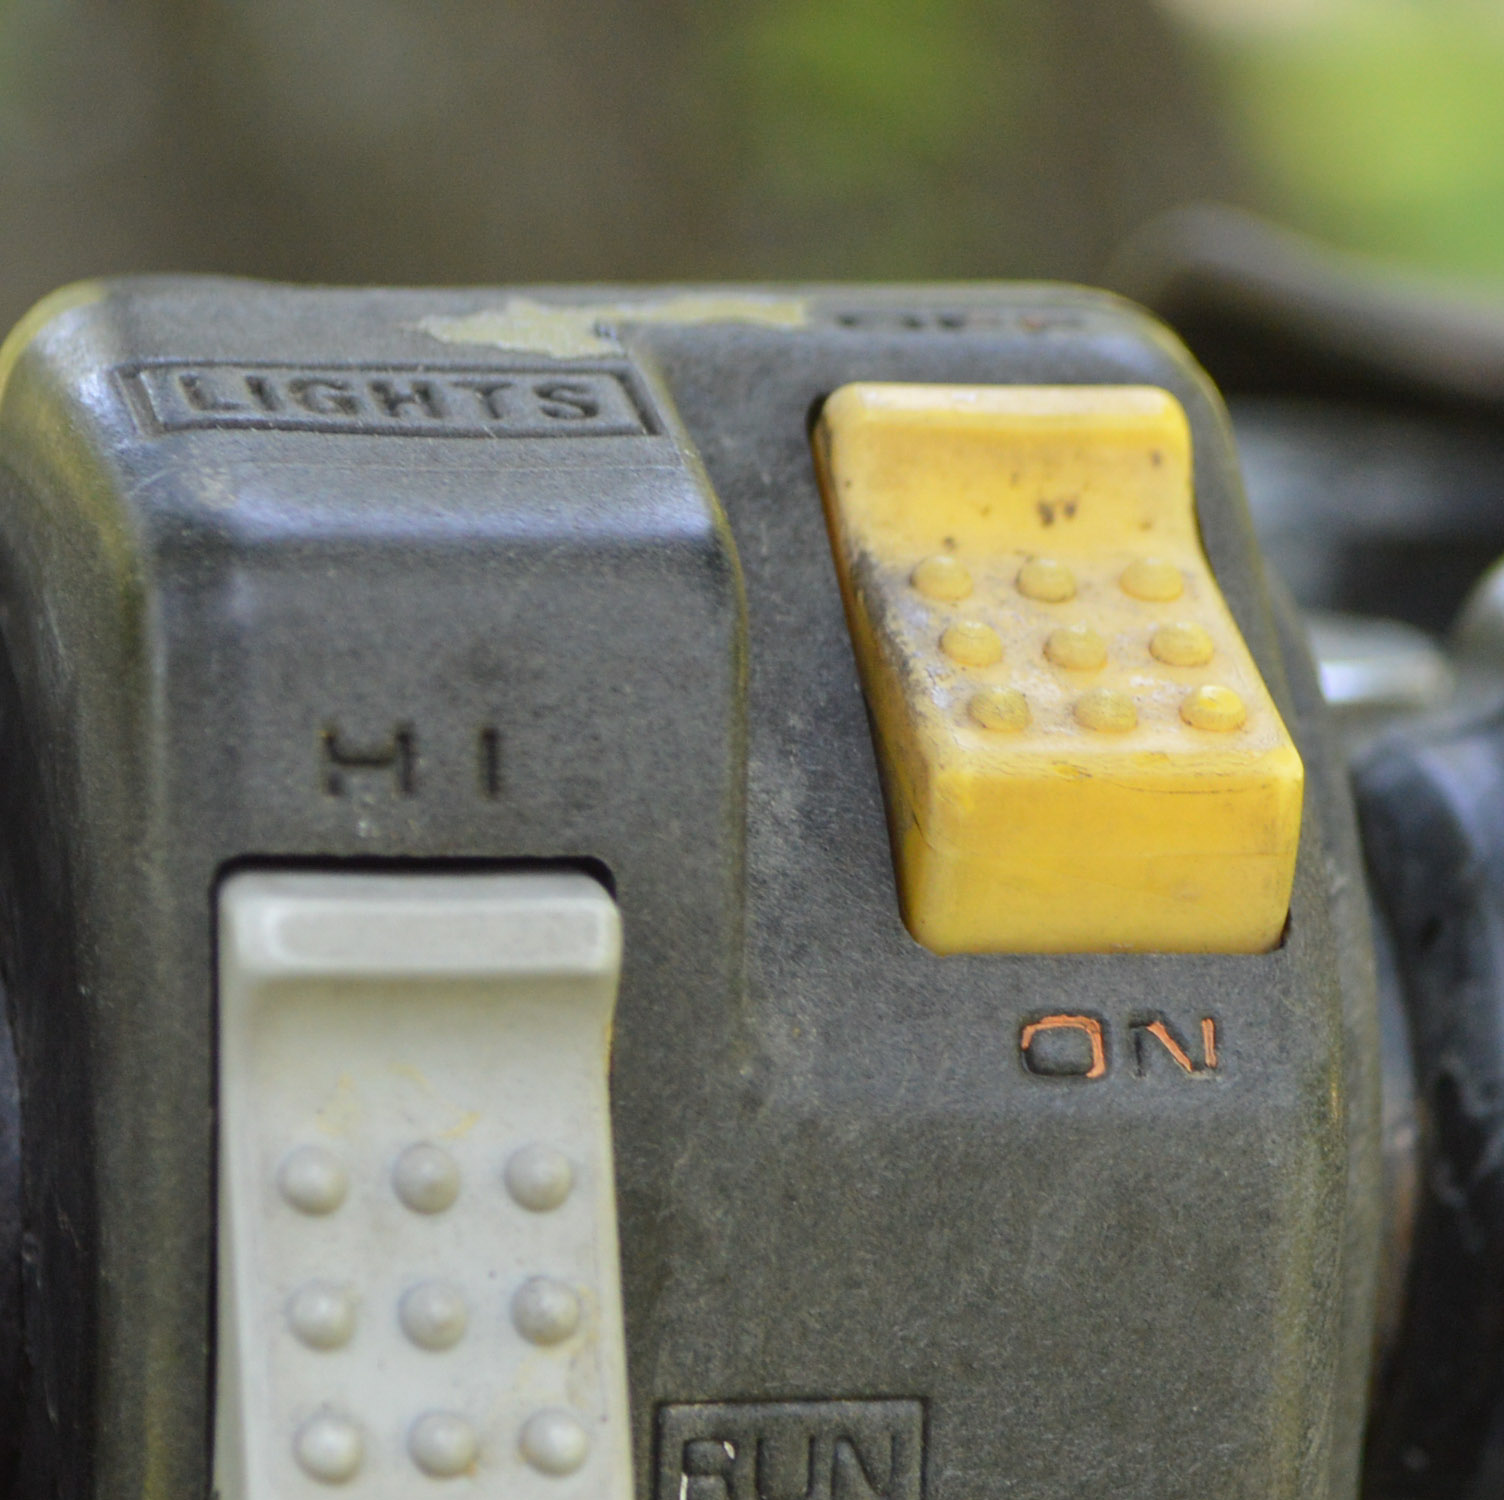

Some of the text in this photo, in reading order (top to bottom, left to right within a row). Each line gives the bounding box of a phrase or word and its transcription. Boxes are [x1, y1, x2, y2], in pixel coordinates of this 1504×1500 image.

[178, 372, 600, 421] LIGHTS
[320, 719, 502, 799] HI
[1020, 1013, 1218, 1079] ON
